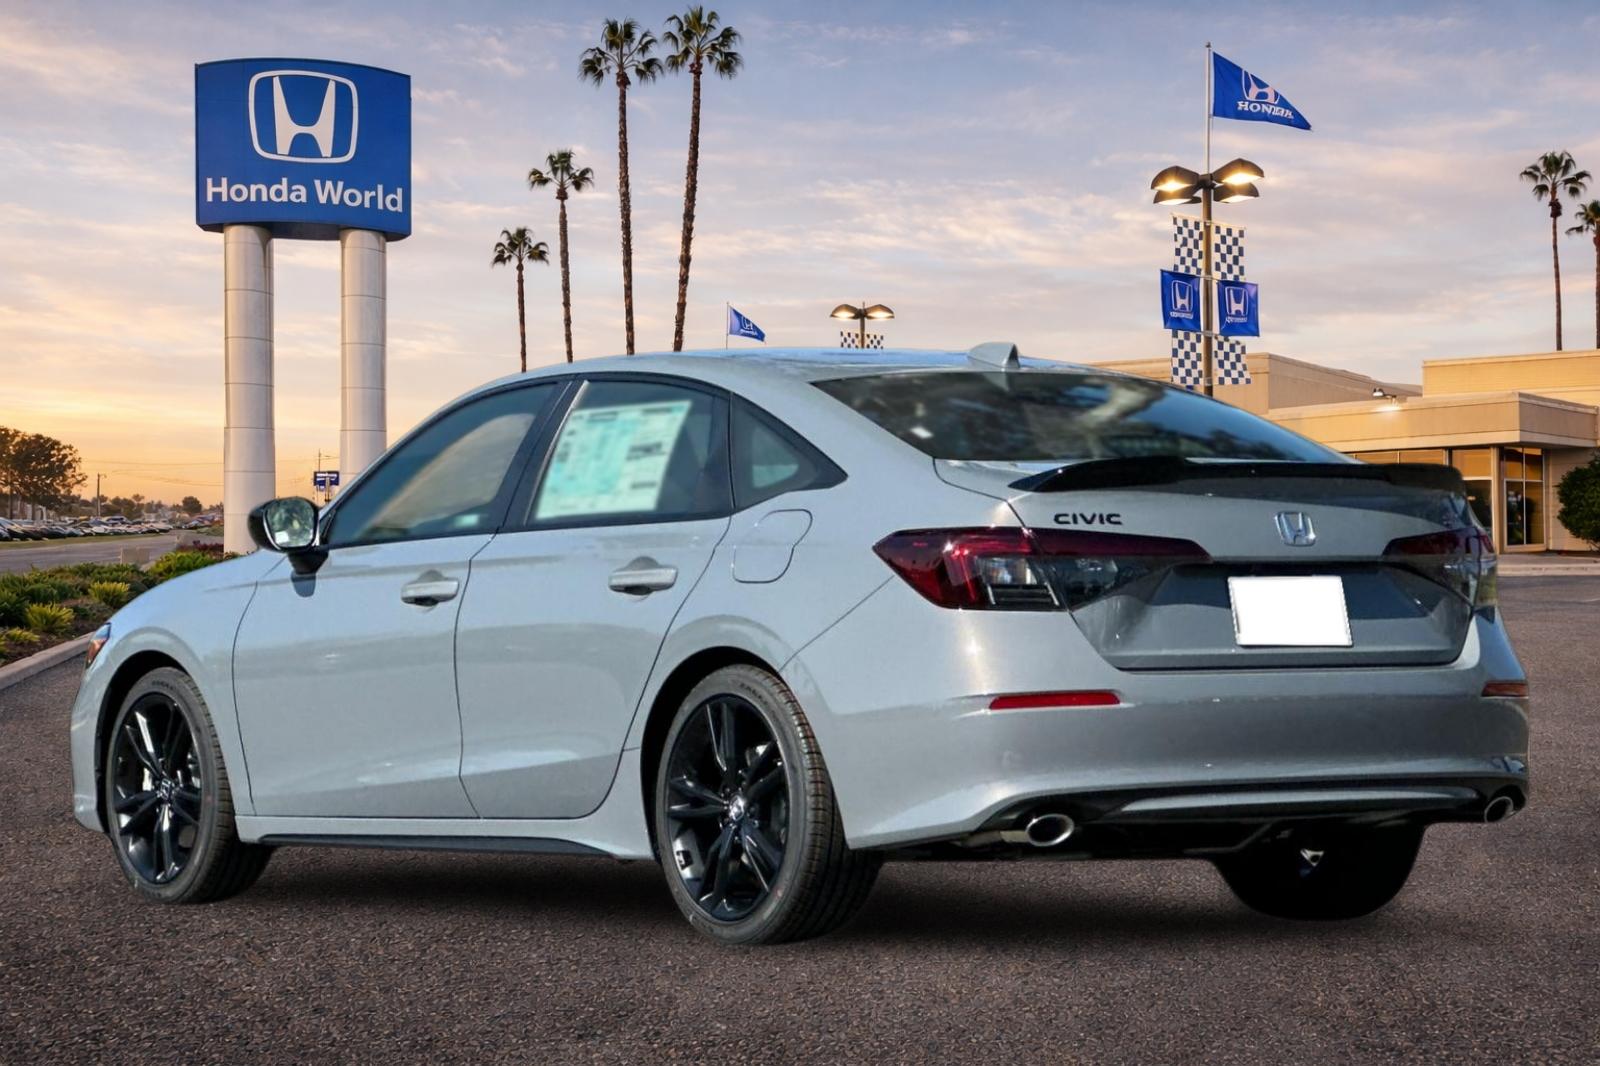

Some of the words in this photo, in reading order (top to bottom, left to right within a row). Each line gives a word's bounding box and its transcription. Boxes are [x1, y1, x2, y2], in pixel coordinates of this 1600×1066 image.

[206, 176, 308, 203] Honda
[313, 178, 403, 213] World
[1053, 511, 1123, 526] CIVIC
